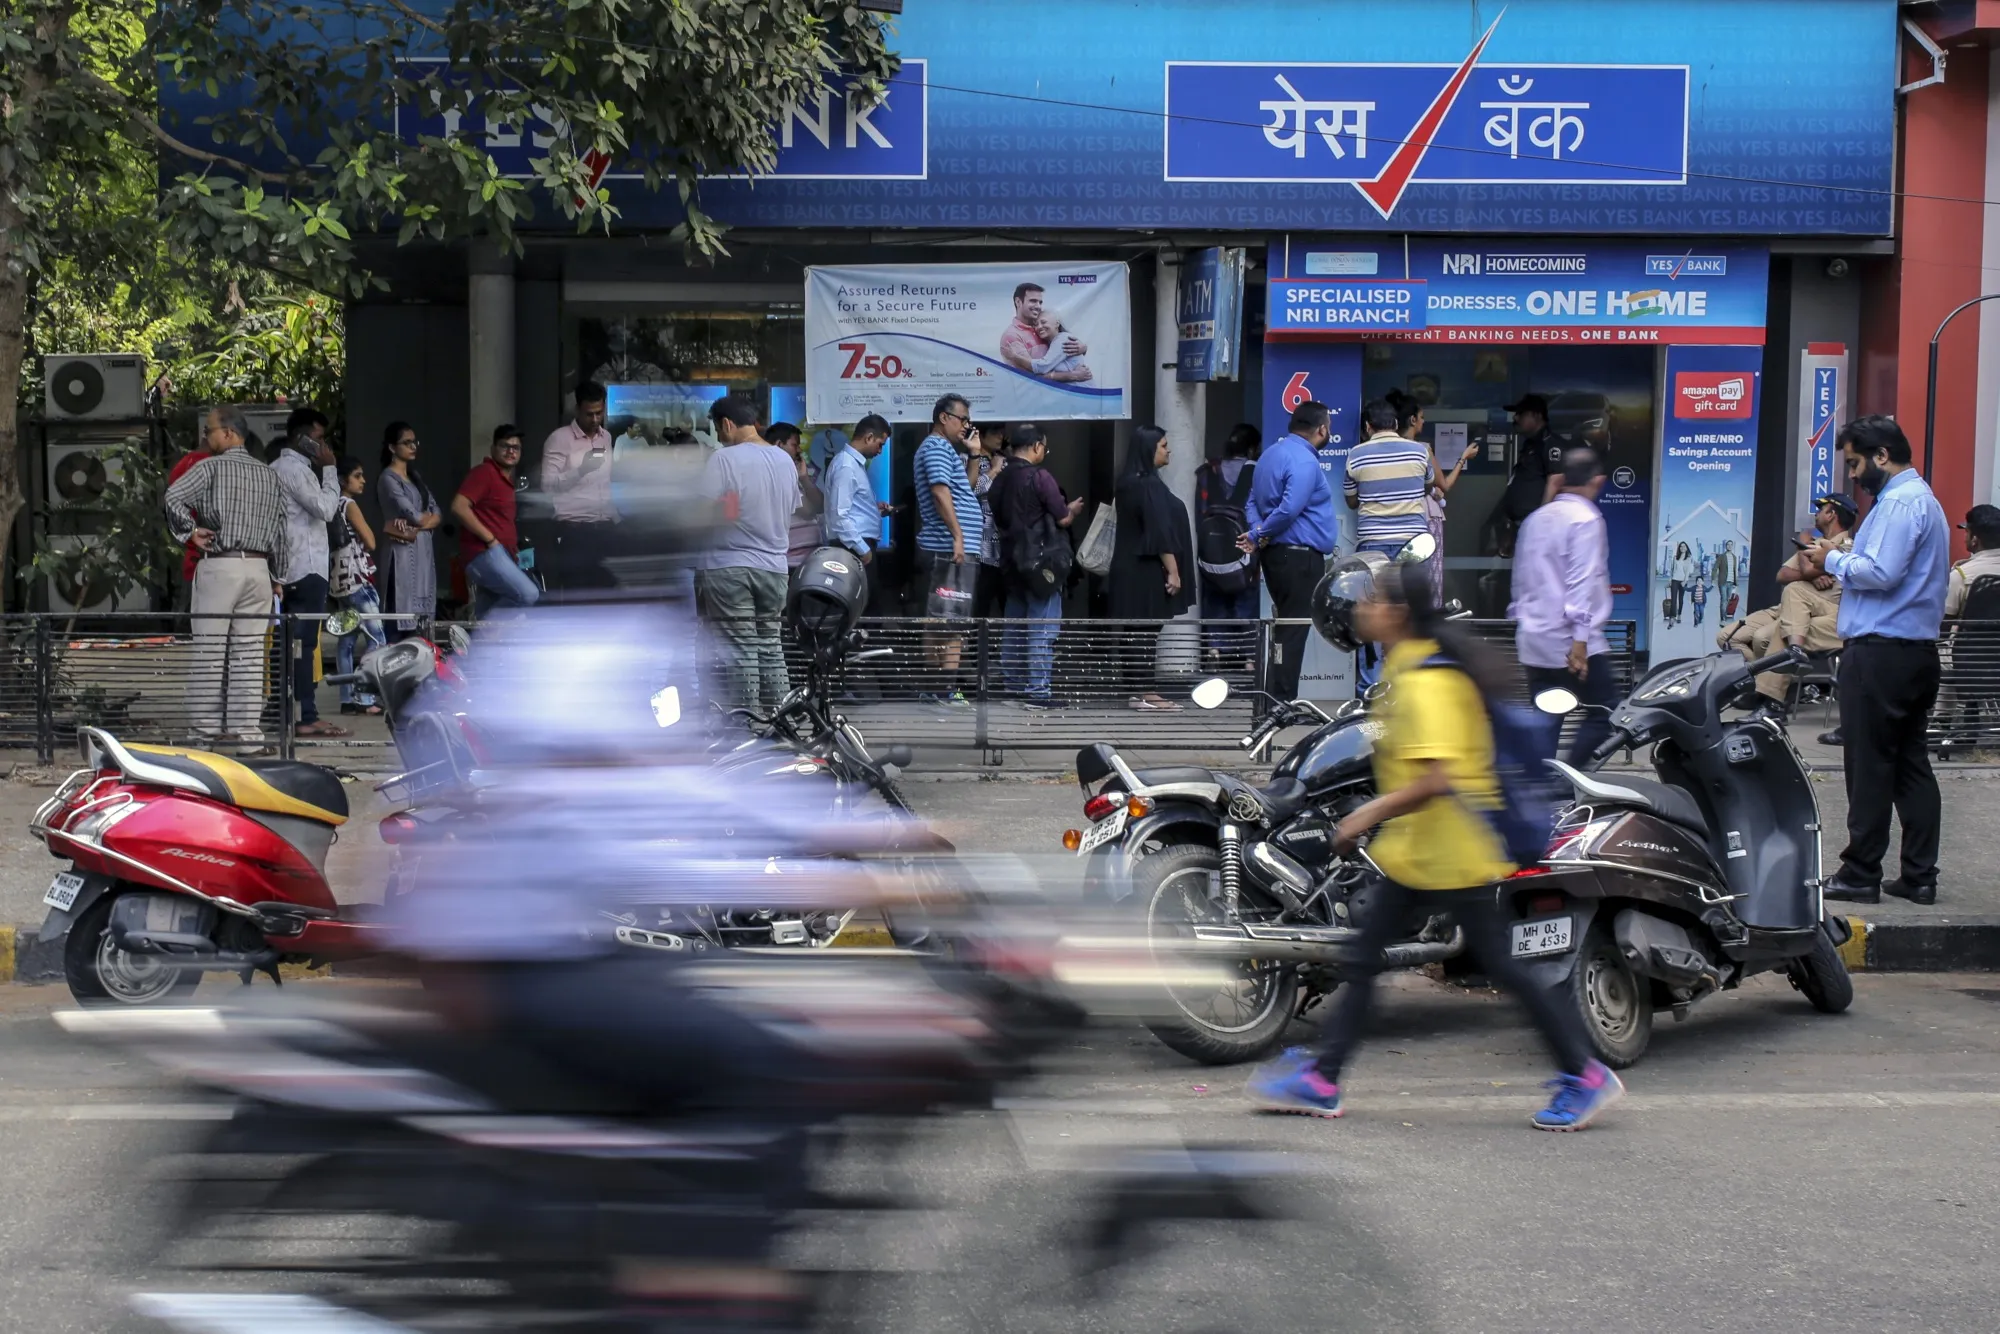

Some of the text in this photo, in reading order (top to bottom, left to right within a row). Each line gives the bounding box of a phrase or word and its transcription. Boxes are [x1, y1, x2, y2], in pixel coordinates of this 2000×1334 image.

[782, 90, 893, 149] NK
[1259, 73, 1375, 160] येस
[1443, 254, 1586, 275] NRI HOMECOMING
[1651, 260, 1720, 271] YES BANK
[837, 284, 957, 297] Assured Returns
[1184, 278, 1212, 315] ATM
[1286, 288, 1411, 304] SPECIALISED
[837, 299, 977, 311] for a Secure Future
[1427, 290, 1707, 317] DDRESSES, ONE HOME
[910, 317, 940, 325] Deposits
[1286, 308, 1410, 324] NRI BRANCH
[1448, 330, 1514, 340] BANKING
[1521, 330, 1574, 341] NEEDS,
[1580, 330, 1611, 340] ONE
[1618, 330, 1659, 340] BANK
[1682, 386, 1739, 397] amazon pay
[1695, 401, 1737, 412] gift card
[1679, 435, 1744, 444] on NRE/NRO
[1668, 447, 1752, 459] Savings Account
[1688, 461, 1731, 472] Opening
[1816, 447, 1828, 513] BAN
[158, 848, 236, 867] Activa
[1523, 922, 1558, 938] MH 03
[1518, 932, 1568, 951] DE 4538
